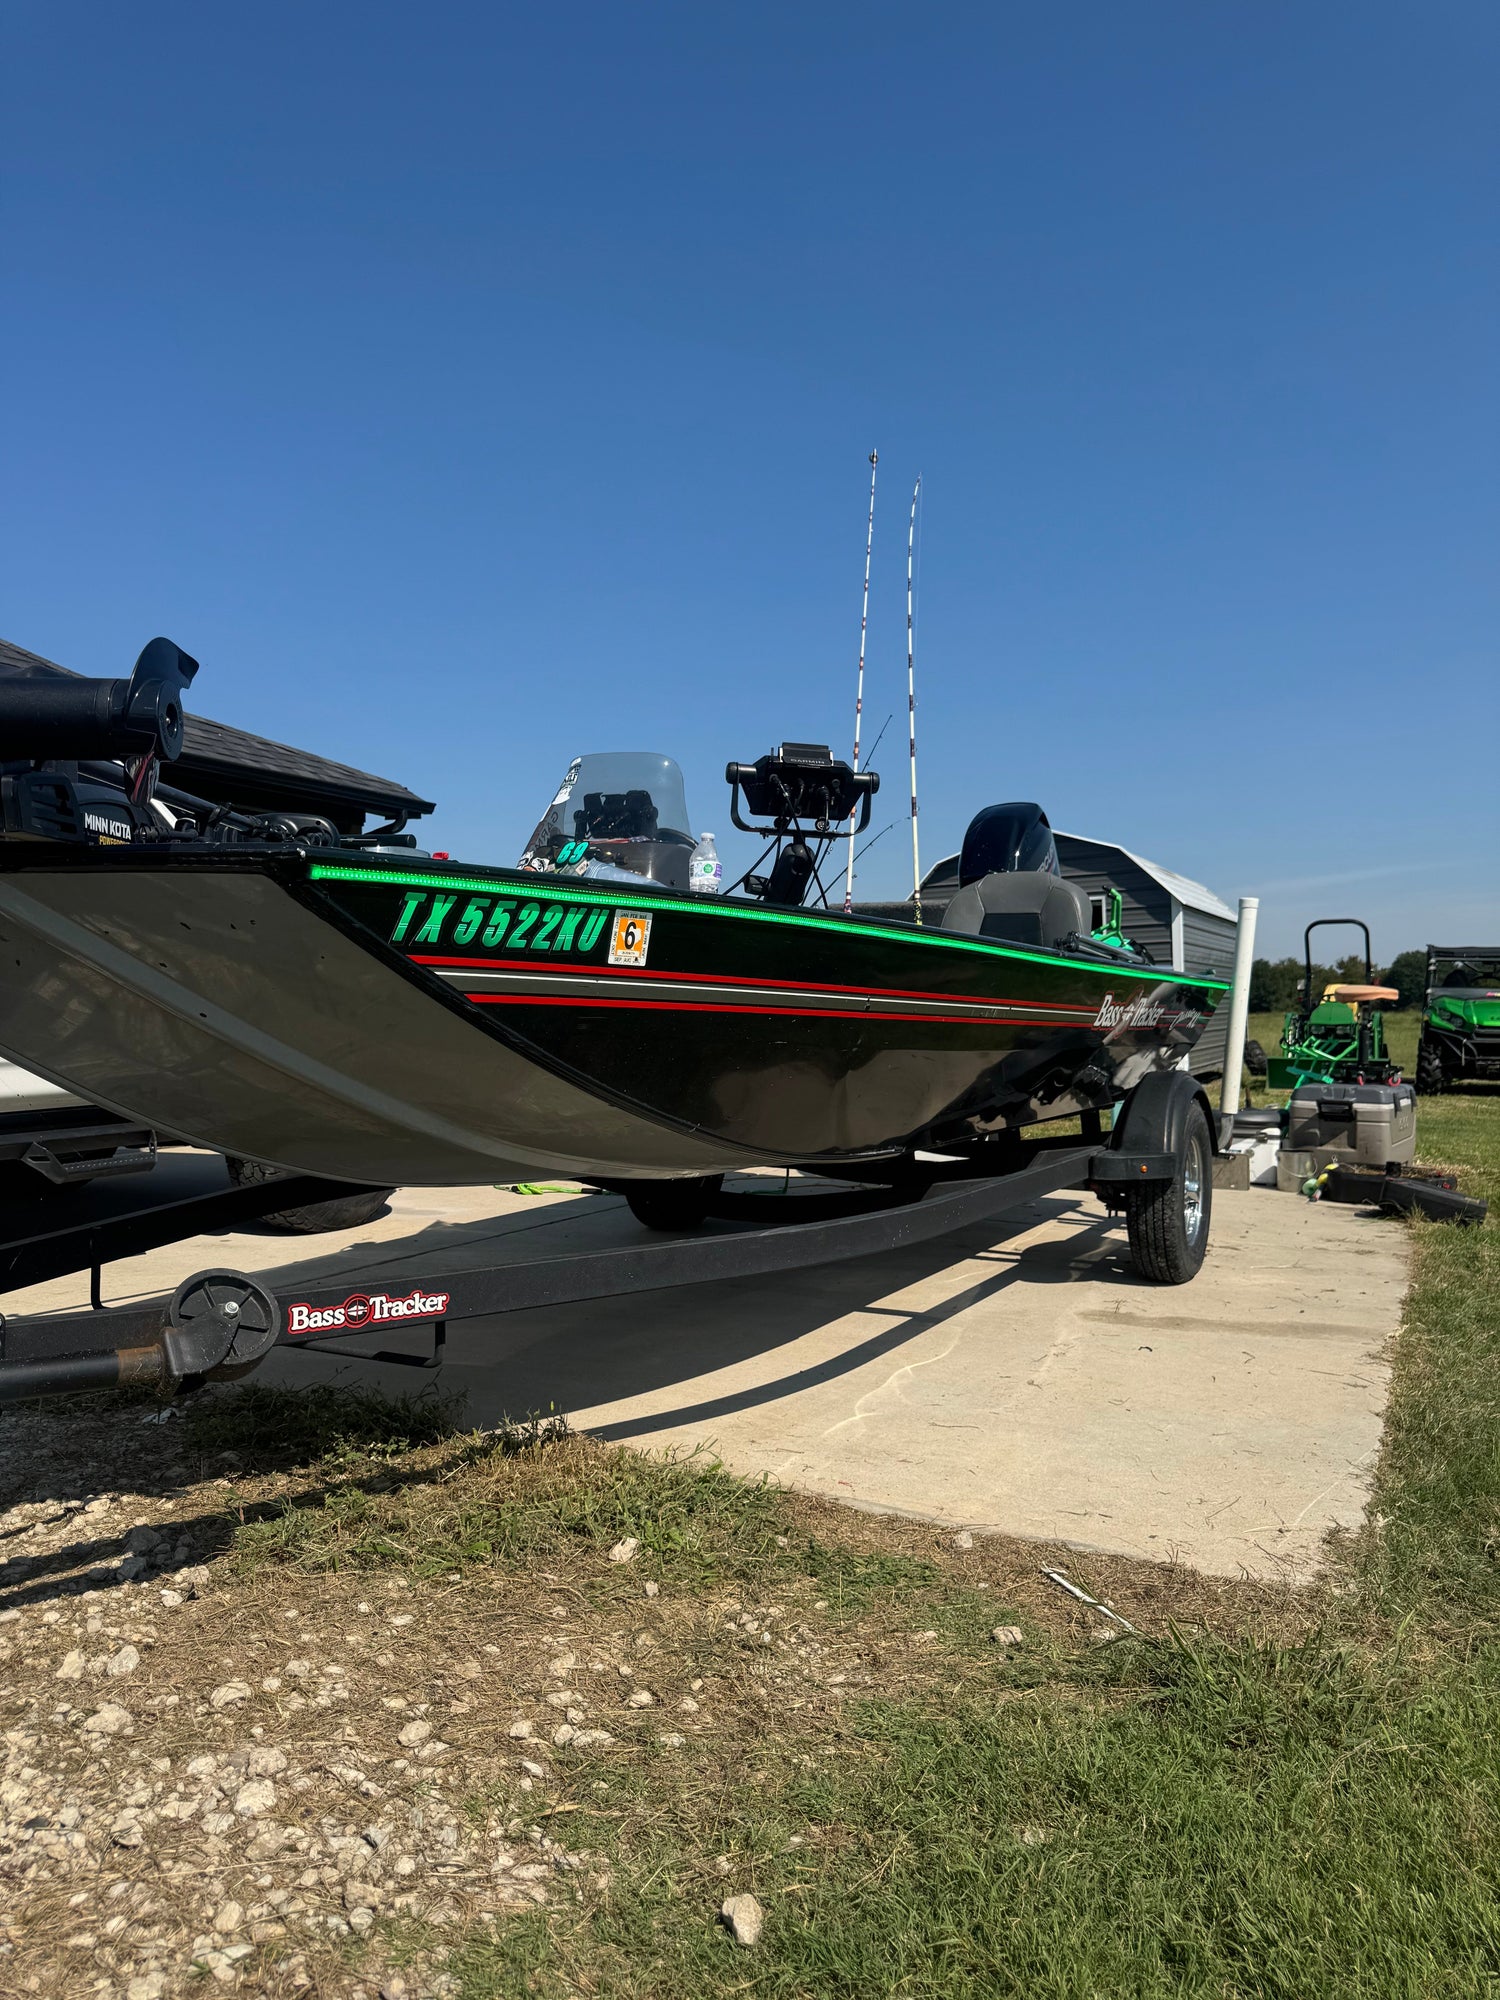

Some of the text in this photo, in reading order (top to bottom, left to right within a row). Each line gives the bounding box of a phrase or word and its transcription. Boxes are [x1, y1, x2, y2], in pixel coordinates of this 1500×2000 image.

[84, 812, 132, 841] MINN KOTA
[556, 841, 589, 864] 69
[391, 891, 610, 952] TX 5522KU
[624, 921, 637, 950] 6
[1093, 994, 1125, 1027] Bass
[290, 1292, 447, 1331] Bass Tracker
